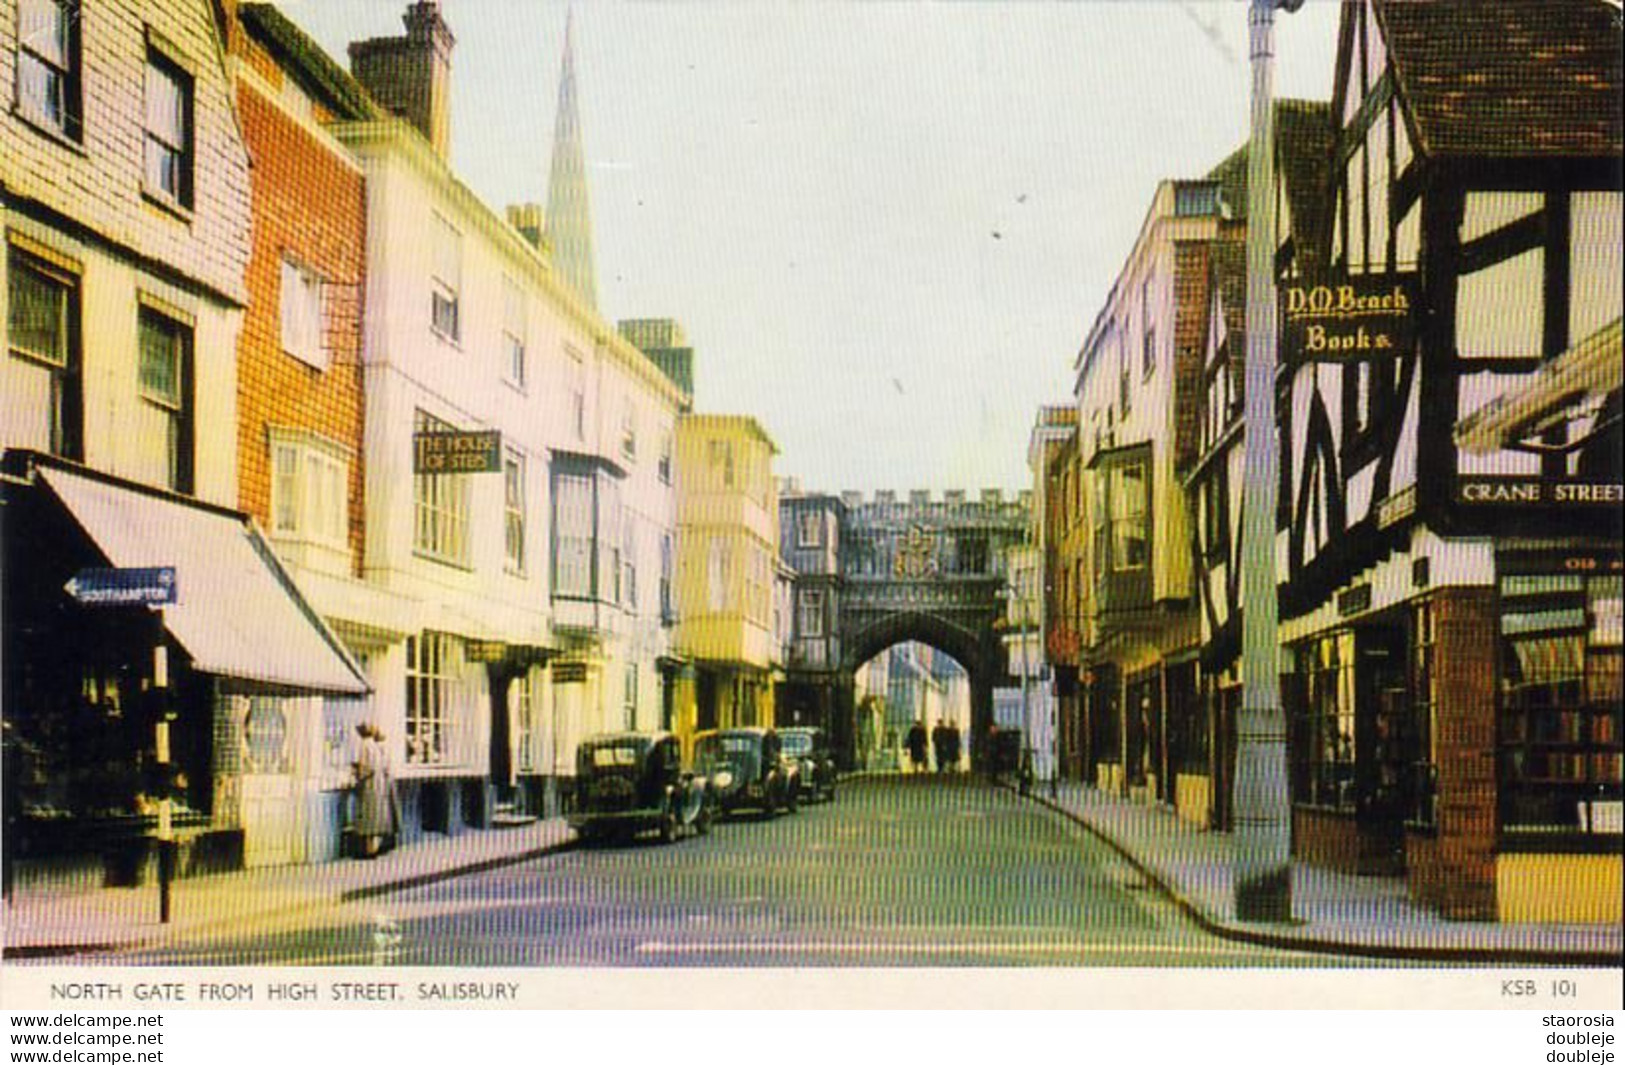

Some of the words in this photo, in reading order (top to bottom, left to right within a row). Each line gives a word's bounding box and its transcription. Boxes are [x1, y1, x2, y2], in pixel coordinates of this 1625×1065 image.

[1305, 325, 1392, 350] Books
[447, 435, 496, 451] HOUSE
[1462, 484, 1540, 501] CRANE
[1555, 484, 1623, 501] STREET
